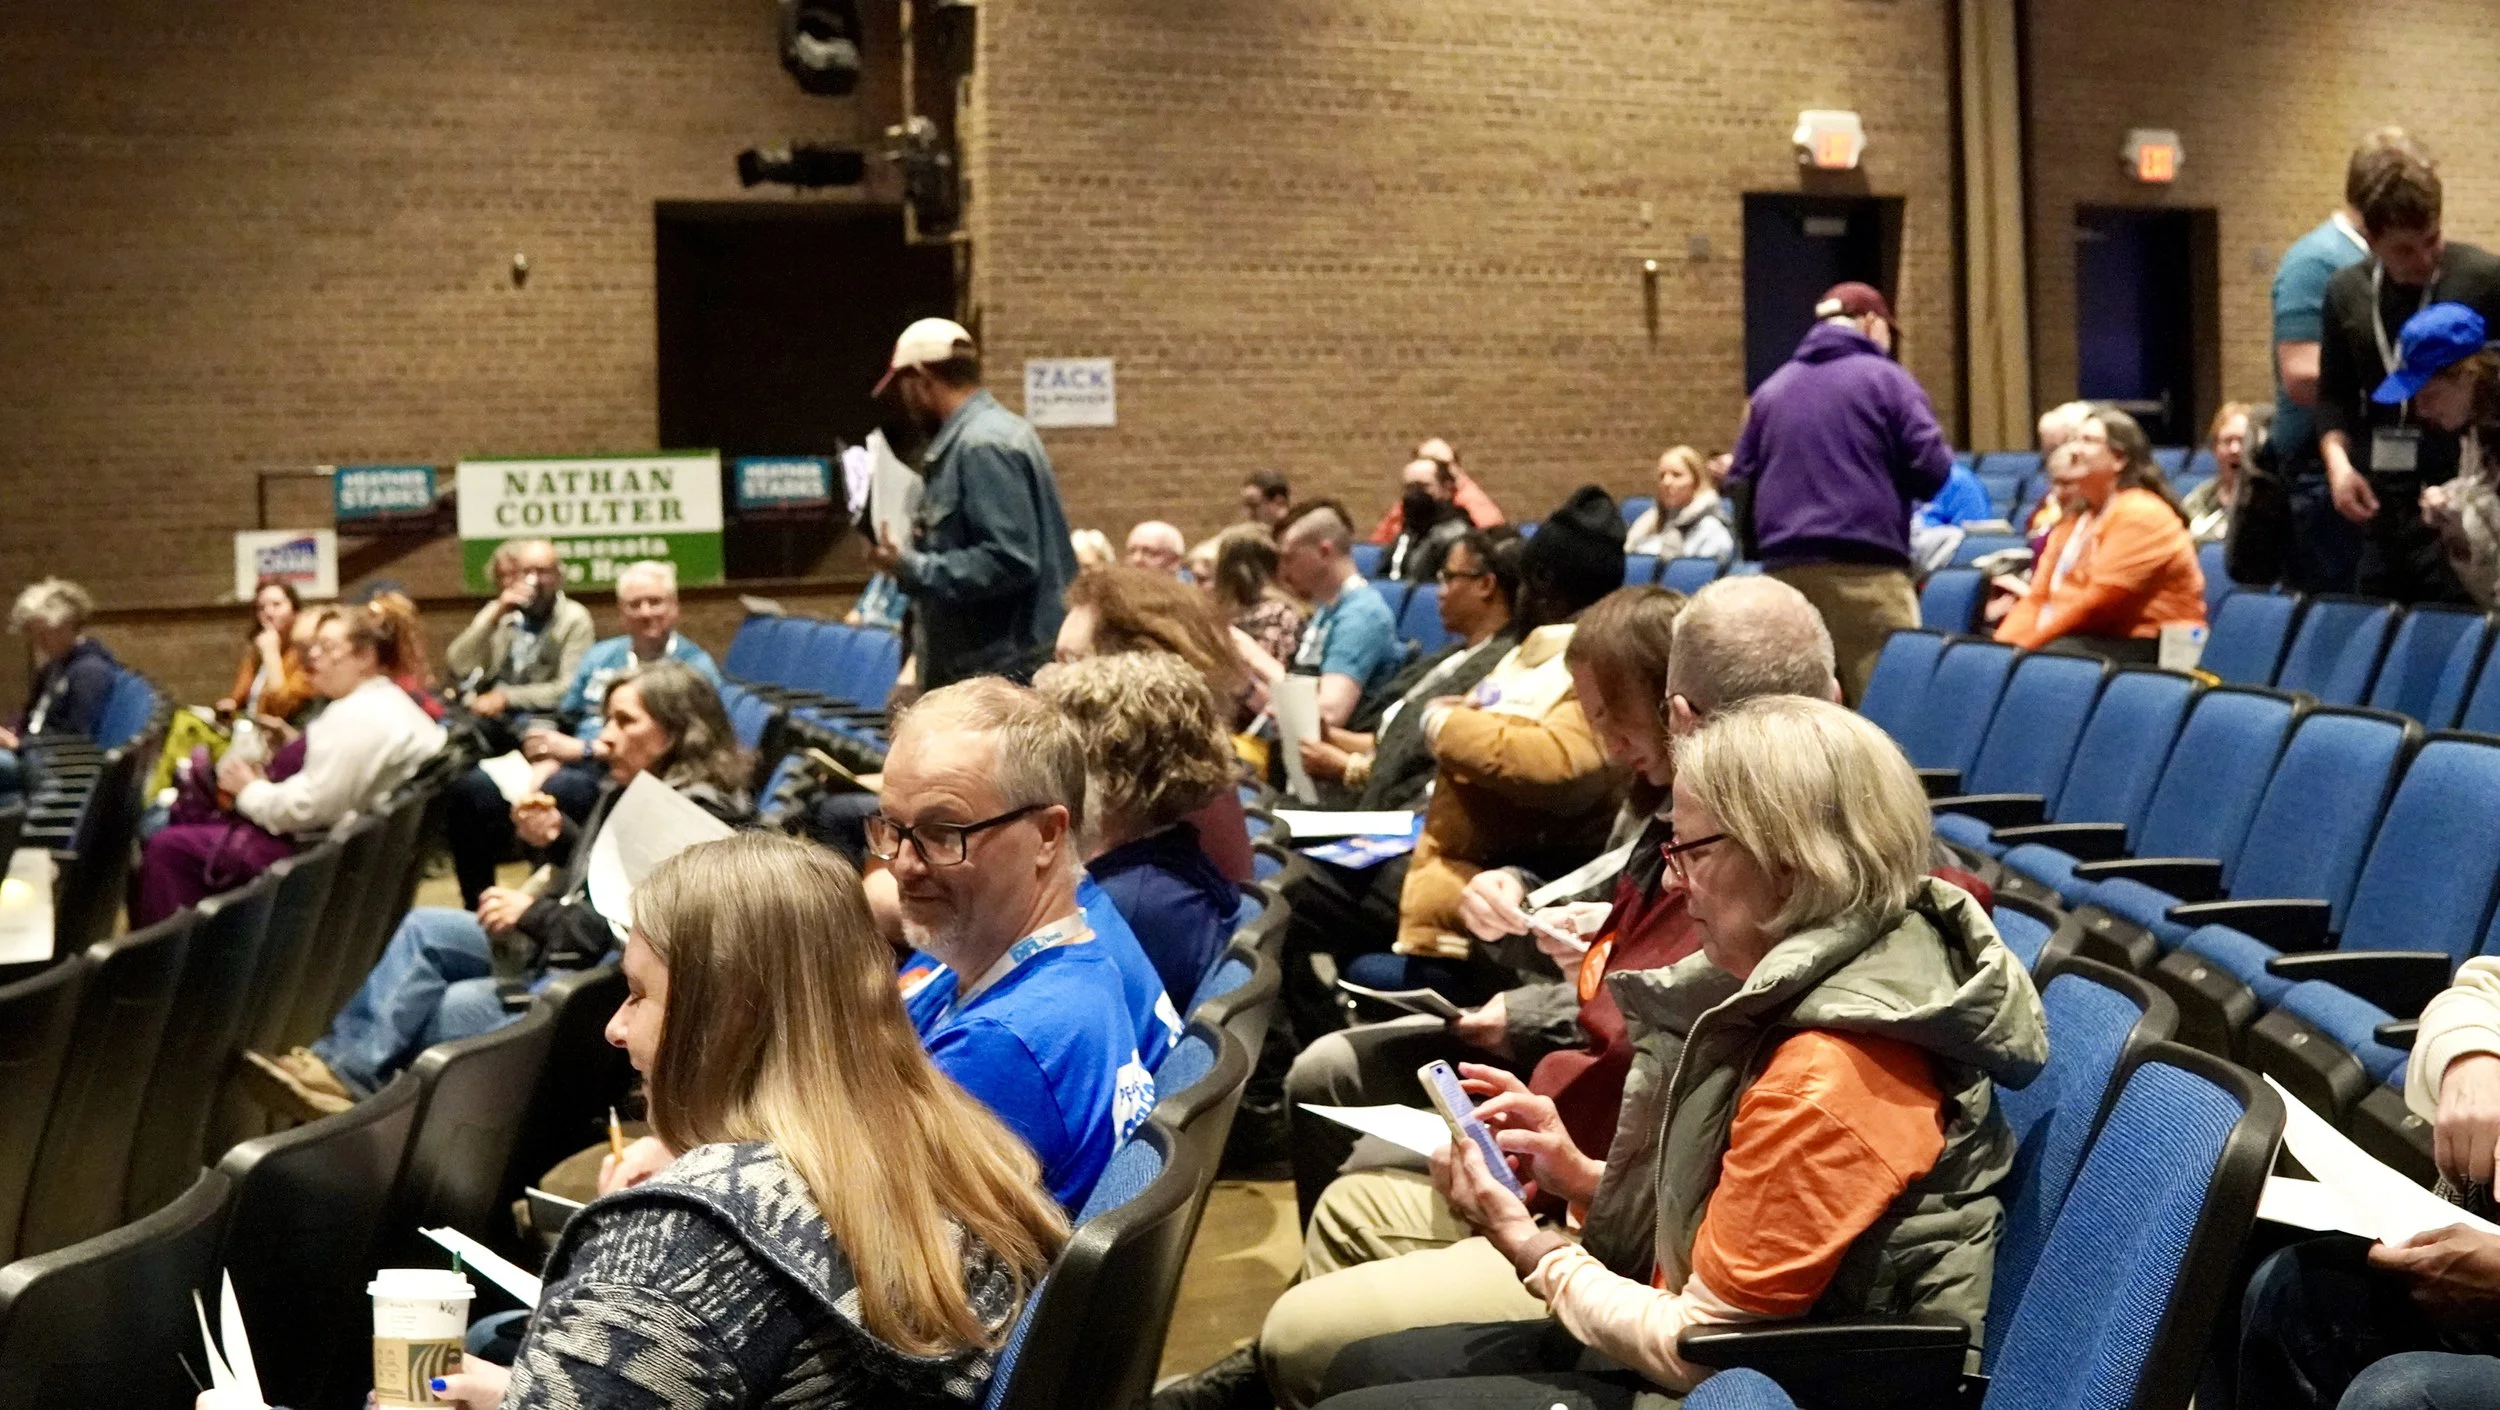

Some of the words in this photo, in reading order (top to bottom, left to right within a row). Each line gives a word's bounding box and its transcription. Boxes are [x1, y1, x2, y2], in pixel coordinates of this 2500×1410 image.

[1032, 366, 1107, 389] ZACK
[504, 467, 675, 495] NATHAN
[495, 499, 685, 528] COULTER
